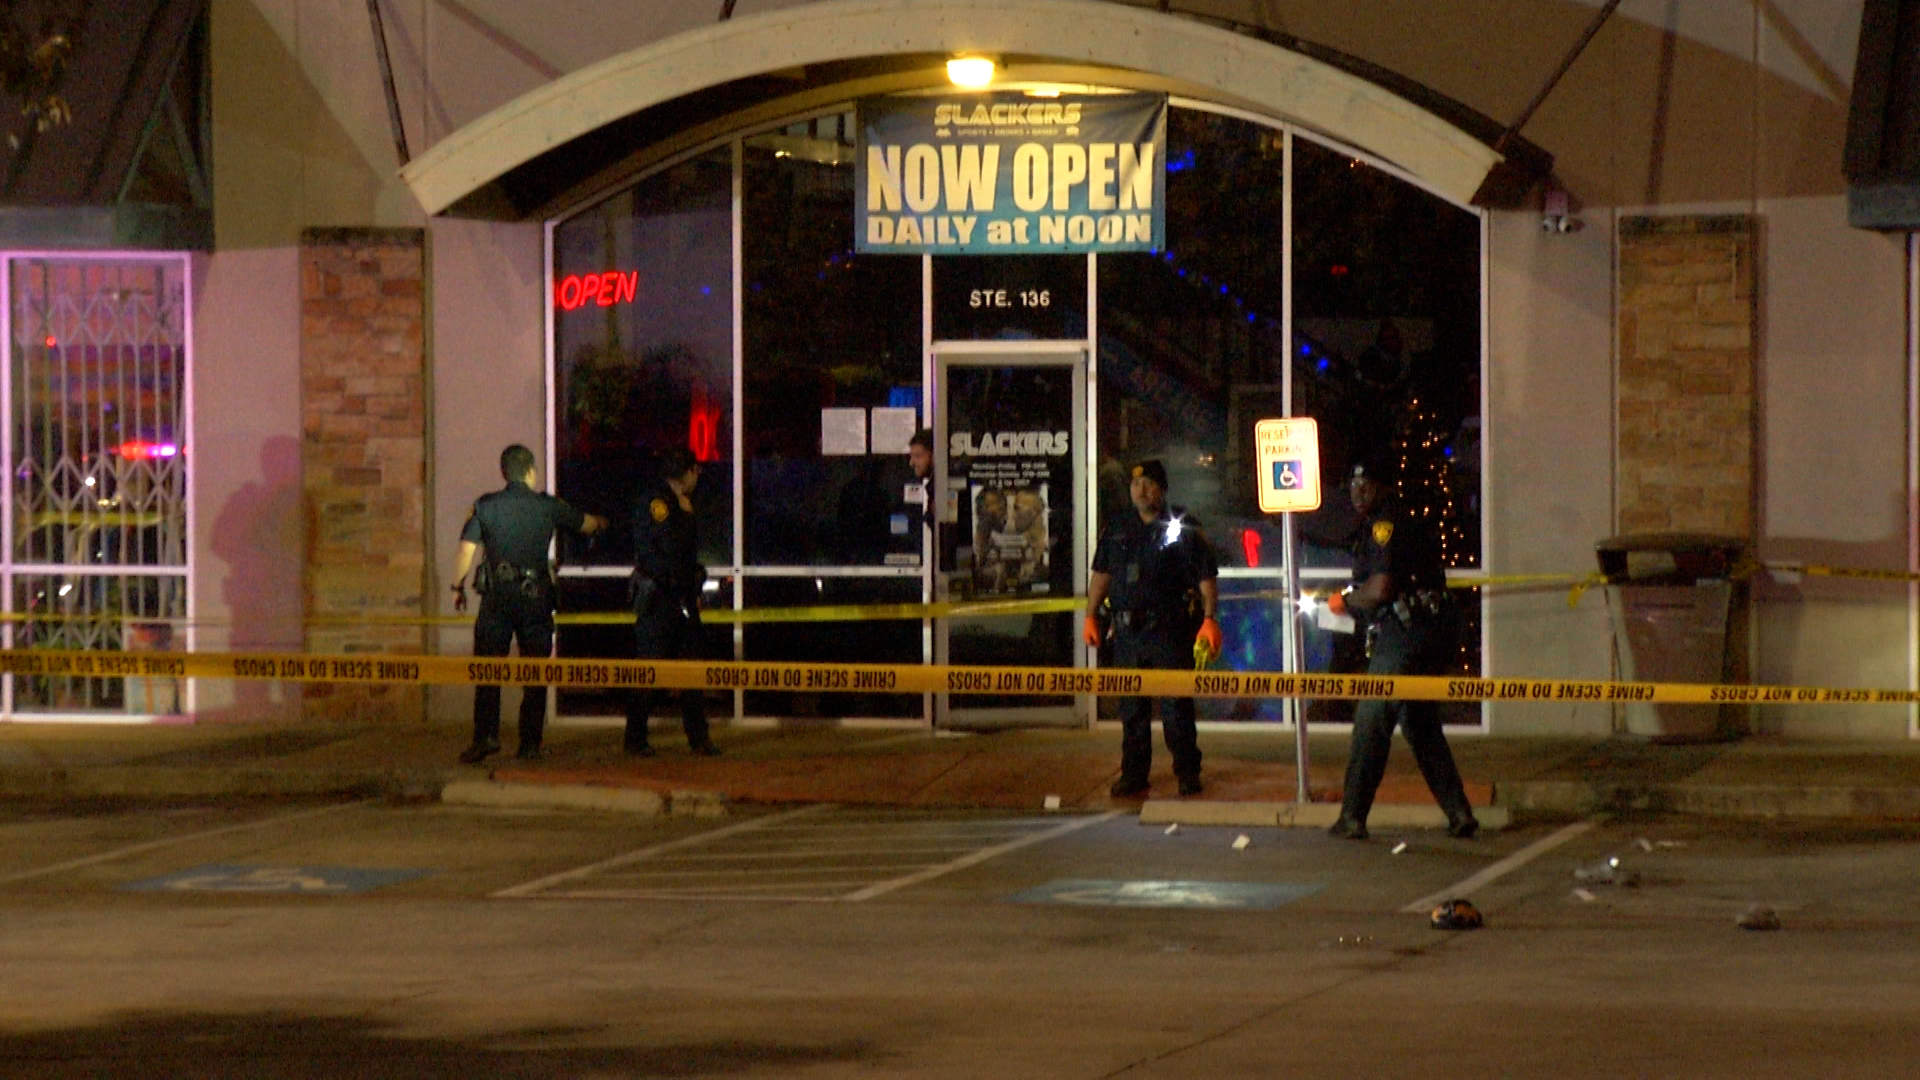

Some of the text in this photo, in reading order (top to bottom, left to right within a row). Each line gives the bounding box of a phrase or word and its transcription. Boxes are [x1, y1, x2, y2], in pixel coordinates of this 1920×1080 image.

[934, 103, 1082, 126] SLACKERS
[867, 142, 1154, 212] NOW OPEN
[867, 215, 1151, 244] DAILY at NOON
[560, 270, 638, 311] OPEN
[969, 289, 1051, 308] STE. 136
[950, 431, 1068, 456] SLACKERS
[1265, 445, 1305, 455] PARKIN
[234, 658, 419, 680] CRIME SCENE DO NOT CROSS
[468, 663, 656, 684] CRIME SCENE DO NOT CROSS
[706, 667, 896, 688] CRIME SCENE DO NOT CROSS
[948, 671, 1142, 693] CRIME SCENE DO NOT CROSS
[1194, 675, 1394, 696] CRIME SCENE DO NOT CROSS
[1448, 681, 1655, 700] CRIME SCENE DO NOT CROSS
[1710, 687, 1758, 701] CROSS
[1762, 687, 1792, 701] NOT
[1797, 688, 1818, 701] DO
[1822, 688, 1871, 701] SCENE
